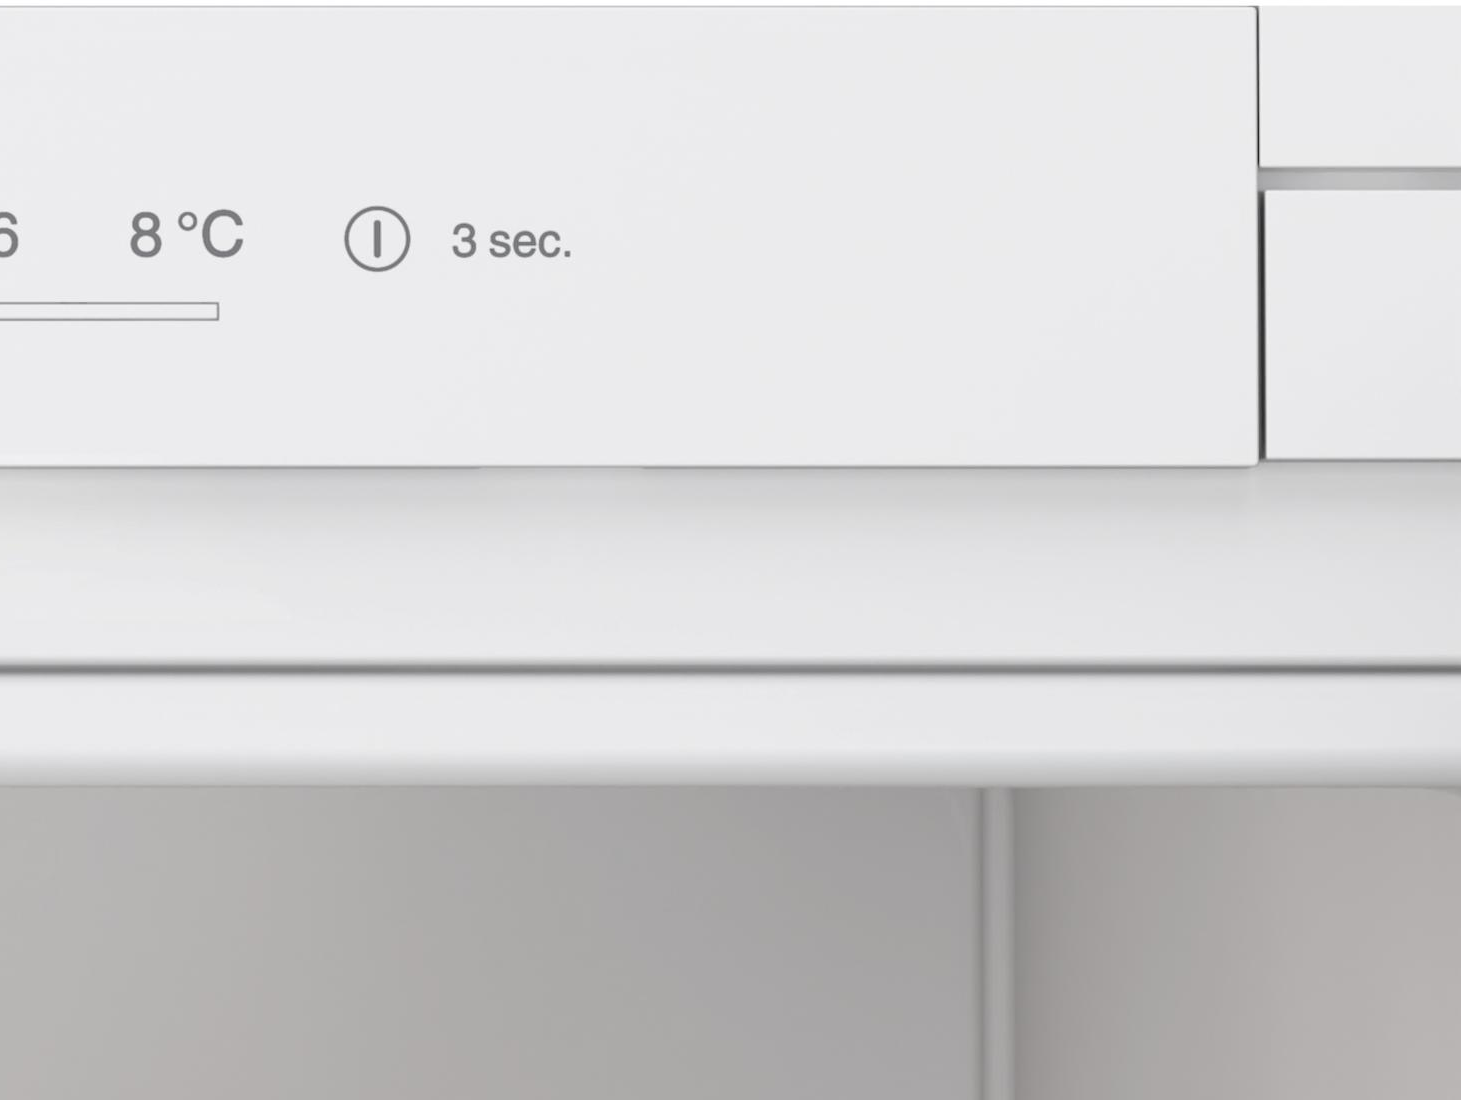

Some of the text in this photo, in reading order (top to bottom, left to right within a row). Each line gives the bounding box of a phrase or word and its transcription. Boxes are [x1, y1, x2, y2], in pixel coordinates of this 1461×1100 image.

[129, 208, 244, 259] 8 °C
[451, 222, 572, 259] 3 sec.
